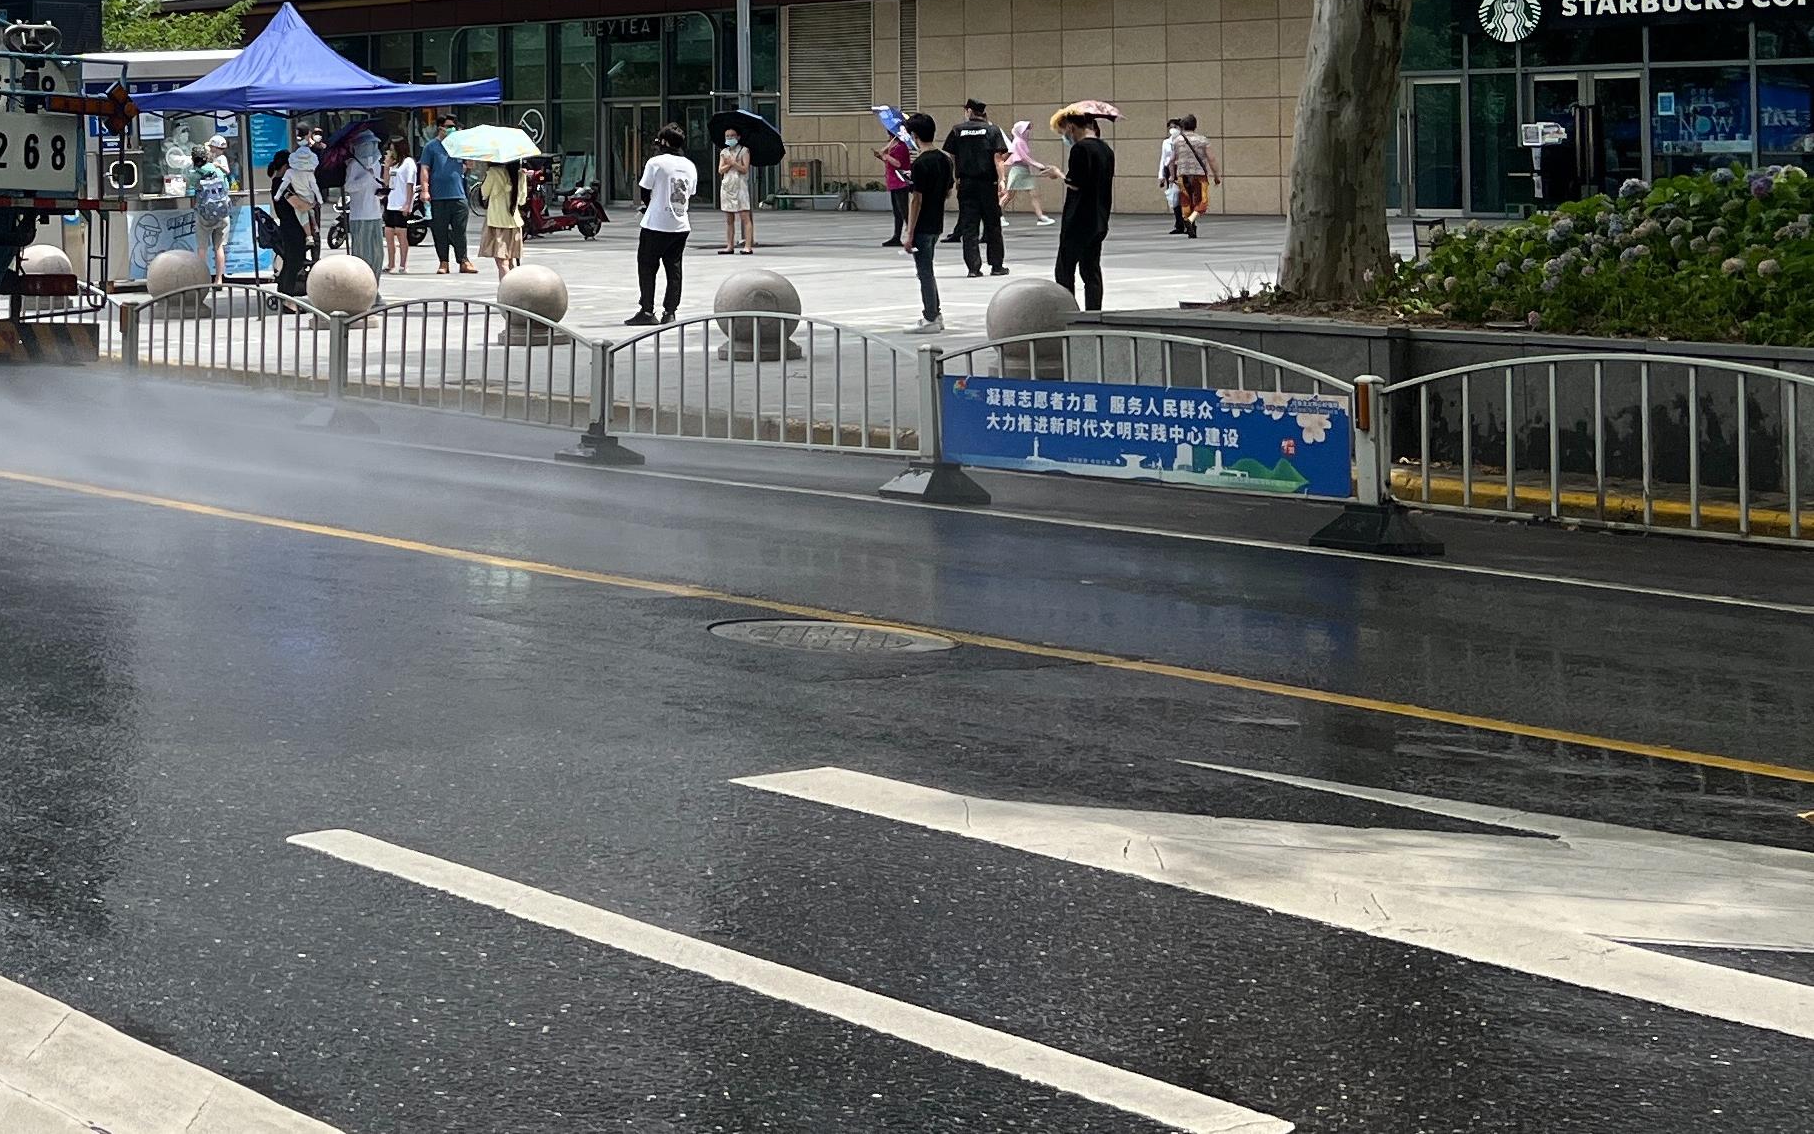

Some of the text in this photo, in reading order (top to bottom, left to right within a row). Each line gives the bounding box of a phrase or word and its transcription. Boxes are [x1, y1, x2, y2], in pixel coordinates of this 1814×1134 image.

[986, 387, 1098, 414] 凝聚志愿者力量
[1109, 395, 1214, 420] 服务人民群众
[986, 412, 1240, 448] 大力推进新时代文明实践中心建设
